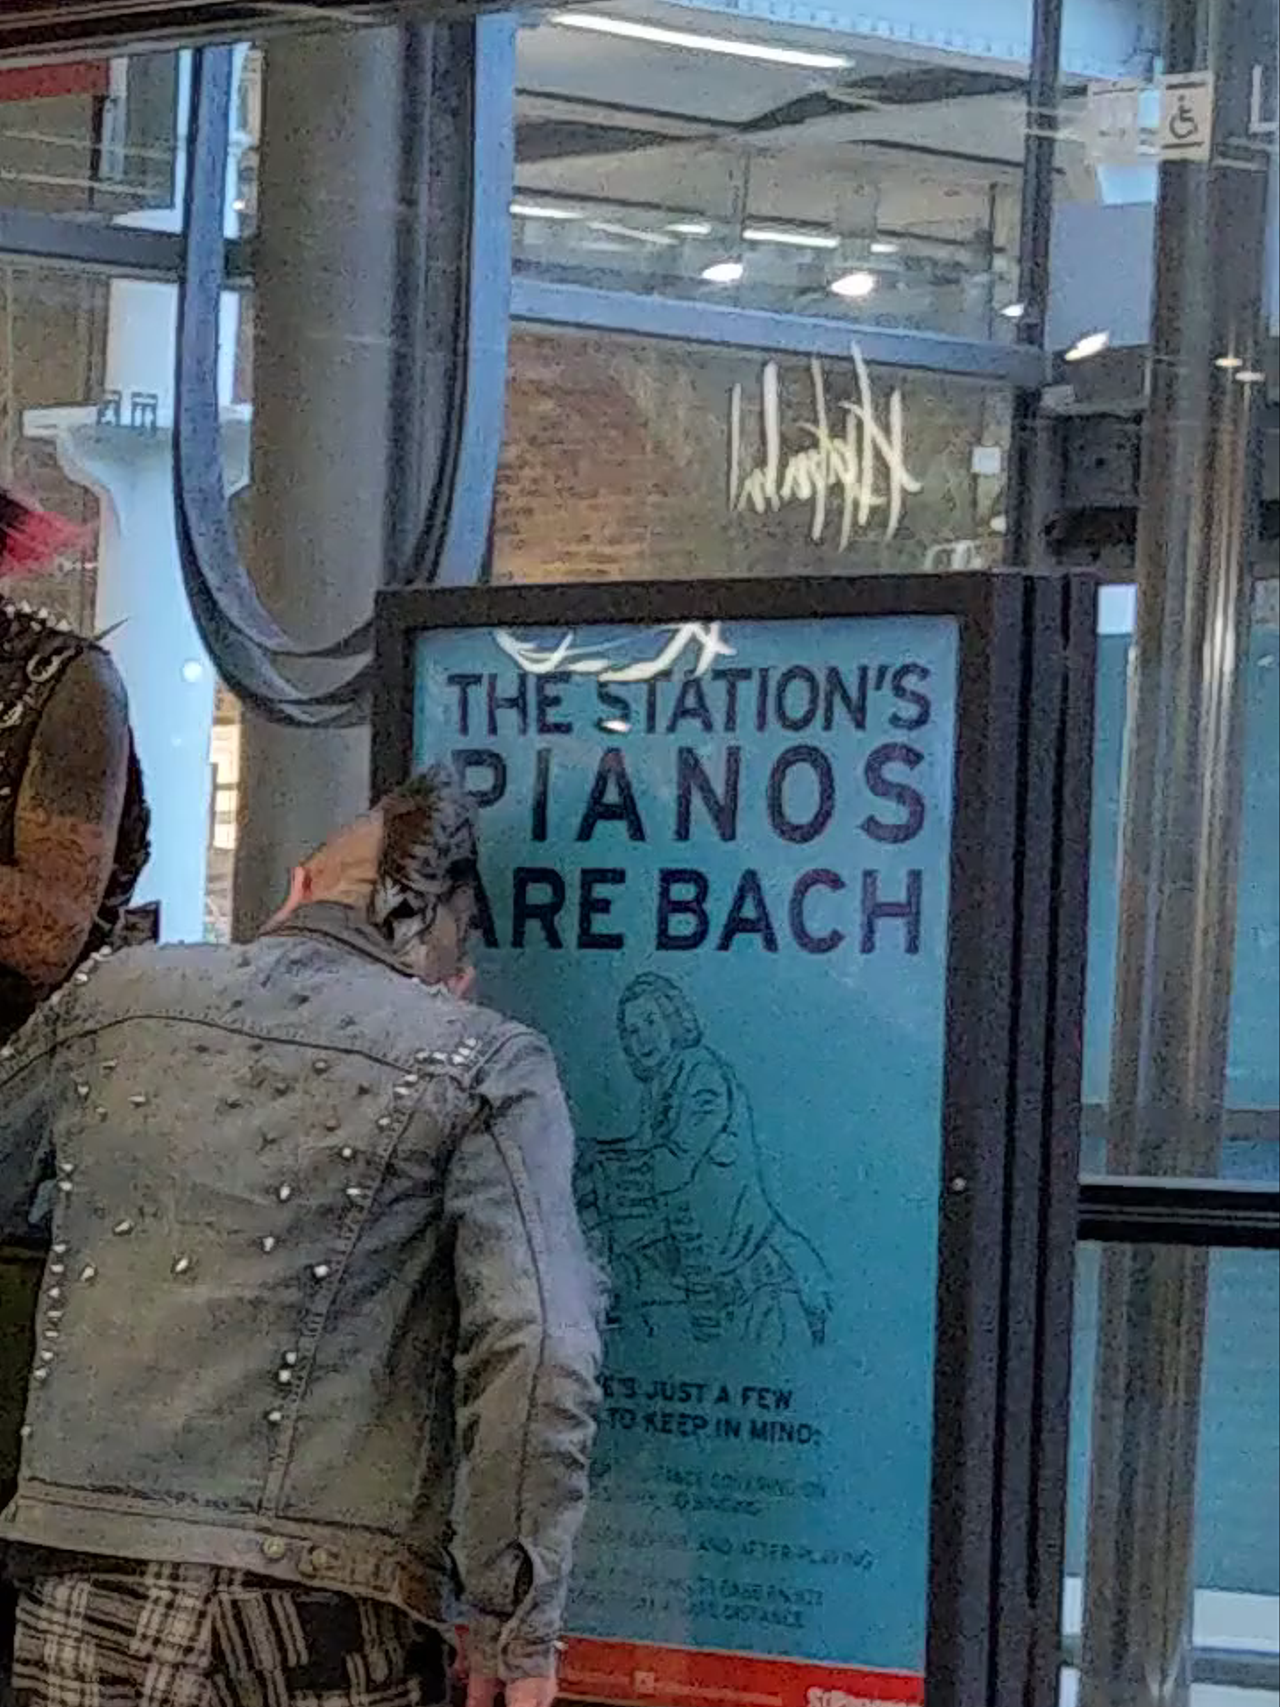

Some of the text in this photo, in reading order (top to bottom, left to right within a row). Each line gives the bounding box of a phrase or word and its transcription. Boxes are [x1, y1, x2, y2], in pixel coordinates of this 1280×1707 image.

[446, 662, 932, 736] THE STATION'S
[450, 742, 927, 845] PIANOS
[654, 866, 922, 955] BACH
[603, 1406, 637, 1430] TO
[640, 1411, 708, 1437] KEEP
[715, 1417, 740, 1438] IN
[645, 1379, 708, 1403] JUST
[713, 1384, 730, 1405] A
[741, 1385, 793, 1410] FEW
